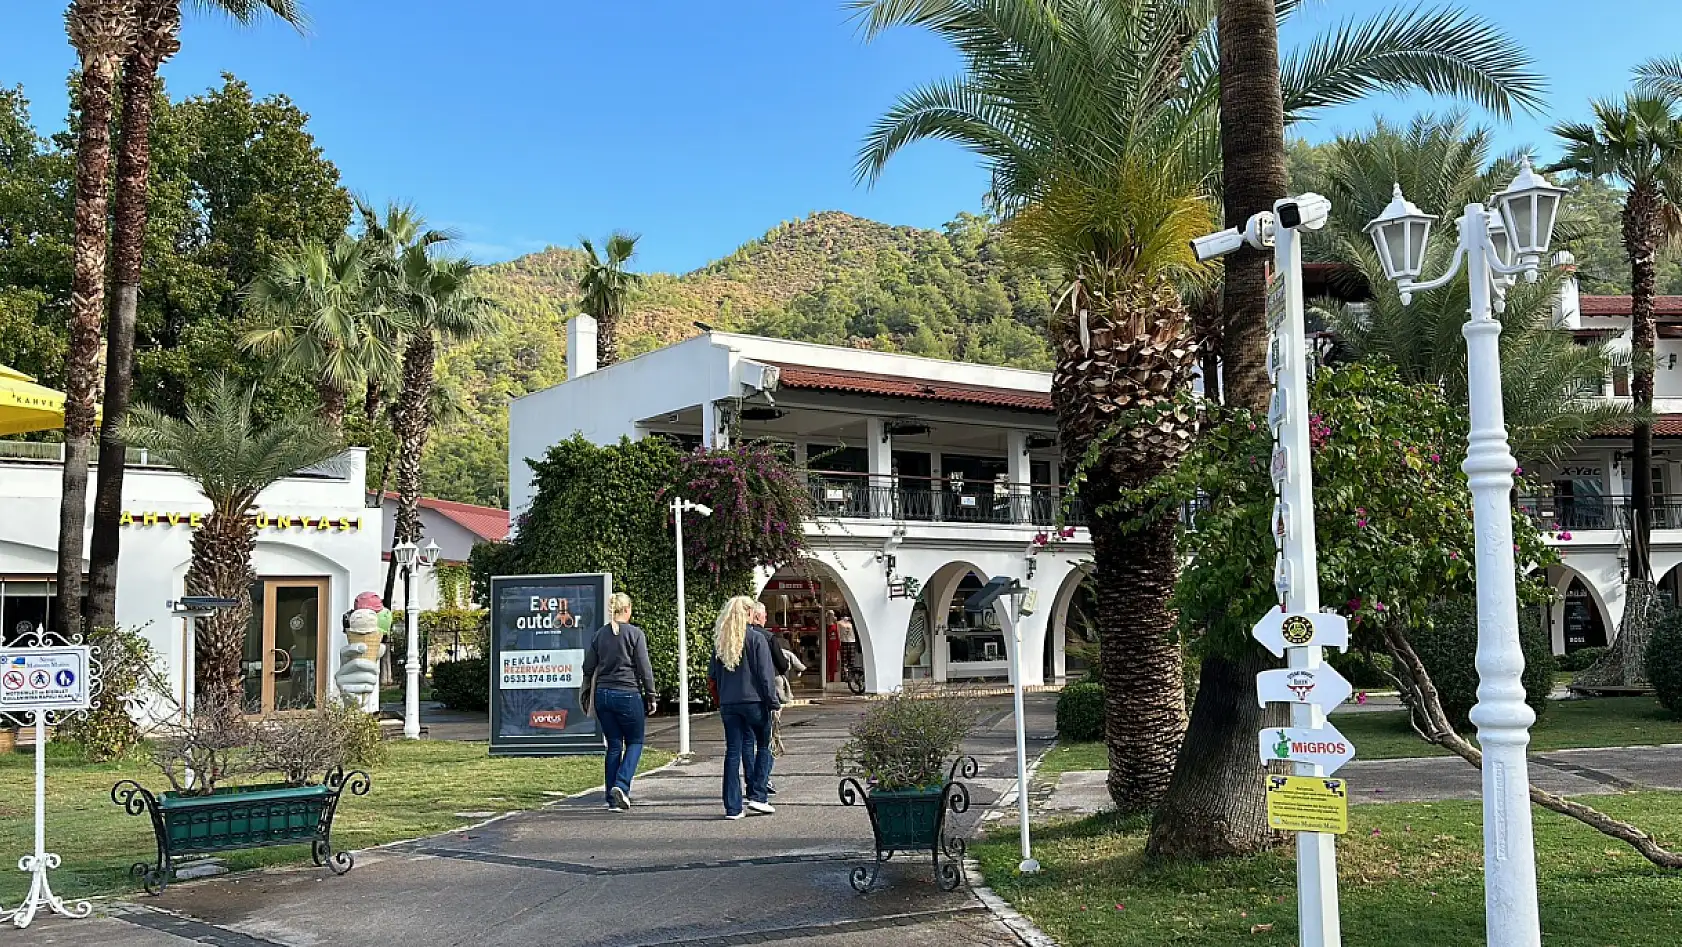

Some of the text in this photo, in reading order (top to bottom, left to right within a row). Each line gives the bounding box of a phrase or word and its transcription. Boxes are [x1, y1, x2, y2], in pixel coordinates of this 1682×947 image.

[16, 396, 54, 407] KAHVE
[1560, 466, 1627, 476] X-Yacs
[119, 511, 363, 530] AHVE ÜNYASI
[530, 596, 569, 611] Exen
[516, 612, 581, 629] outdoor
[503, 654, 551, 667] REKLAM
[503, 664, 572, 674] REZERVASYON
[503, 675, 526, 683] 0533
[559, 674, 572, 682] 48
